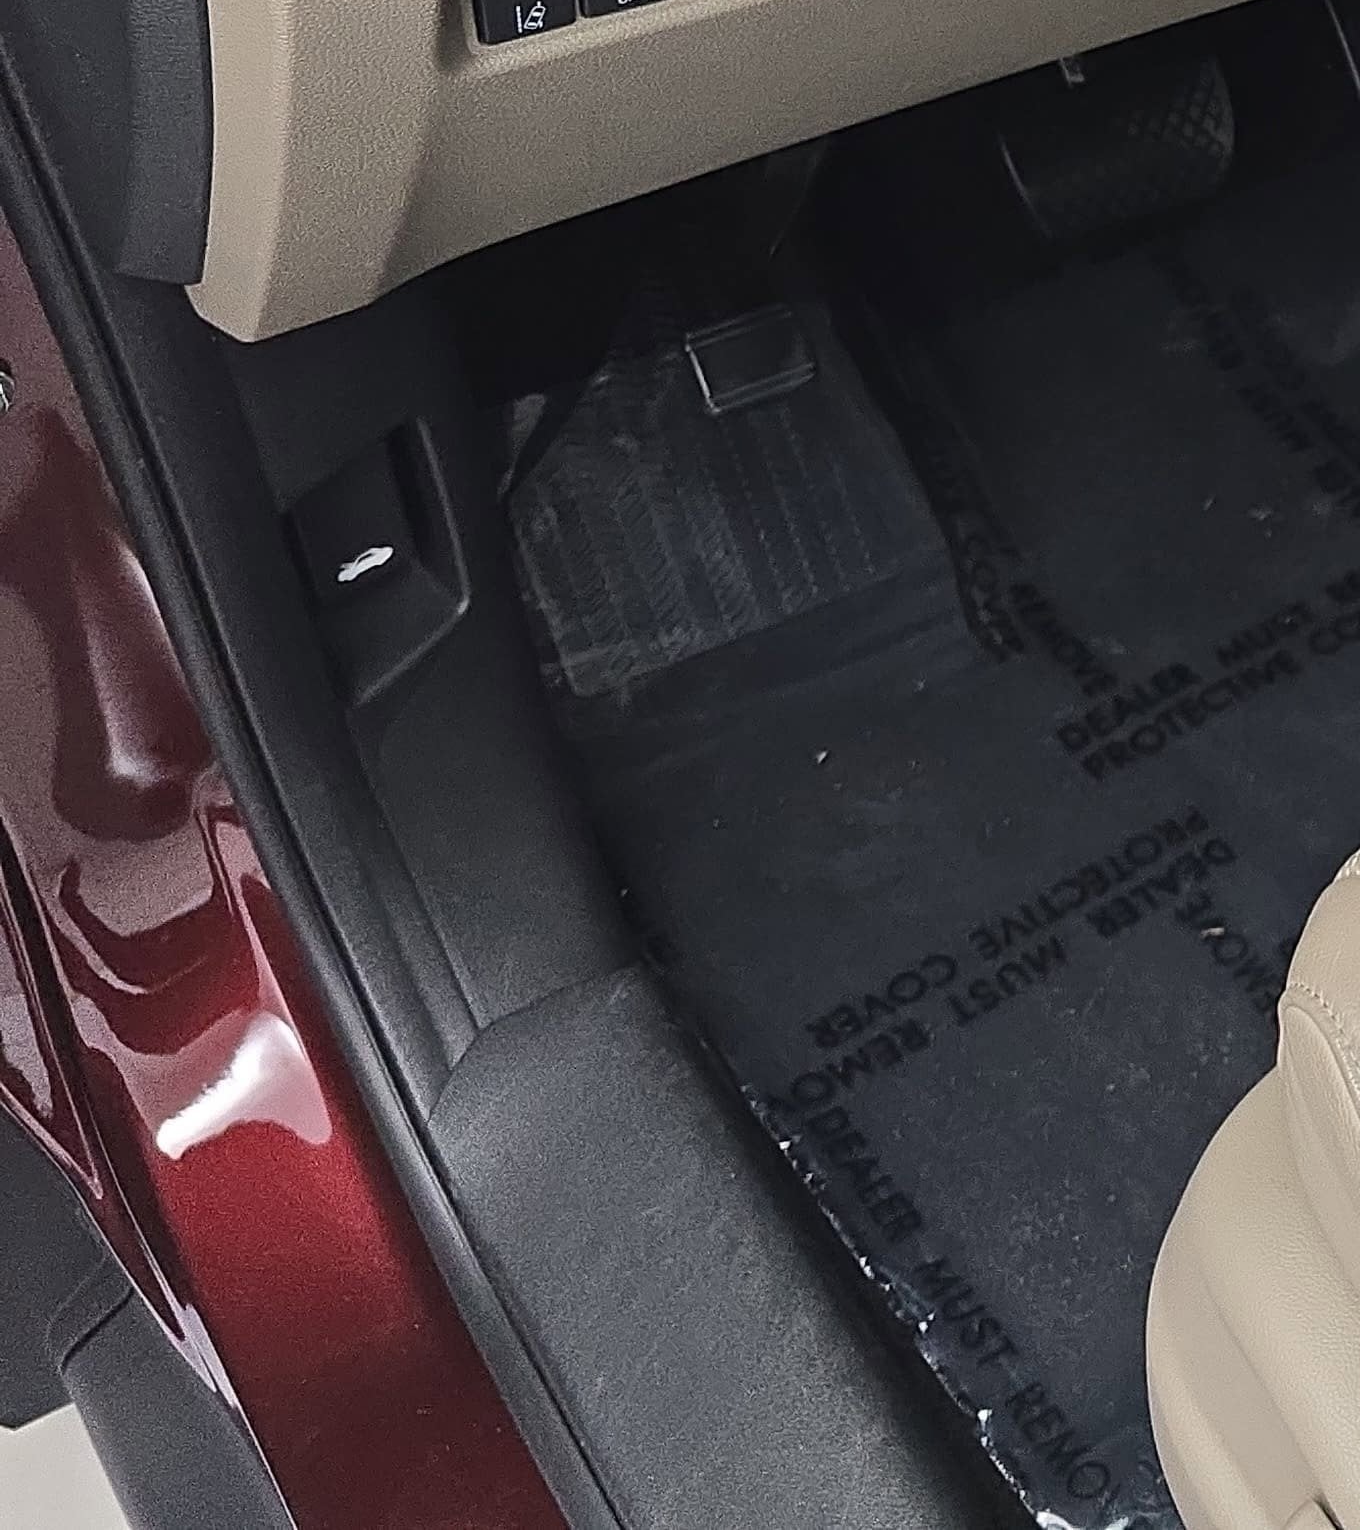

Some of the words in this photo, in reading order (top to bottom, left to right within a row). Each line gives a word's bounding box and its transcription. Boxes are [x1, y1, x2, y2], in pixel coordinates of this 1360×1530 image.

[1055, 658, 1201, 756] DEALER
[1212, 598, 1315, 671] MUST
[1079, 644, 1304, 785] PROTECTIVE
[966, 802, 1209, 962] PROTECTIVE
[1085, 833, 1237, 941] DEALER
[803, 946, 961, 1053] COVER
[945, 935, 1069, 1026] MUST
[1171, 888, 1284, 1016] EMOVE
[759, 1018, 929, 1131] REMOV
[809, 1100, 926, 1248] DEALER
[913, 1251, 1019, 1375] MUST
